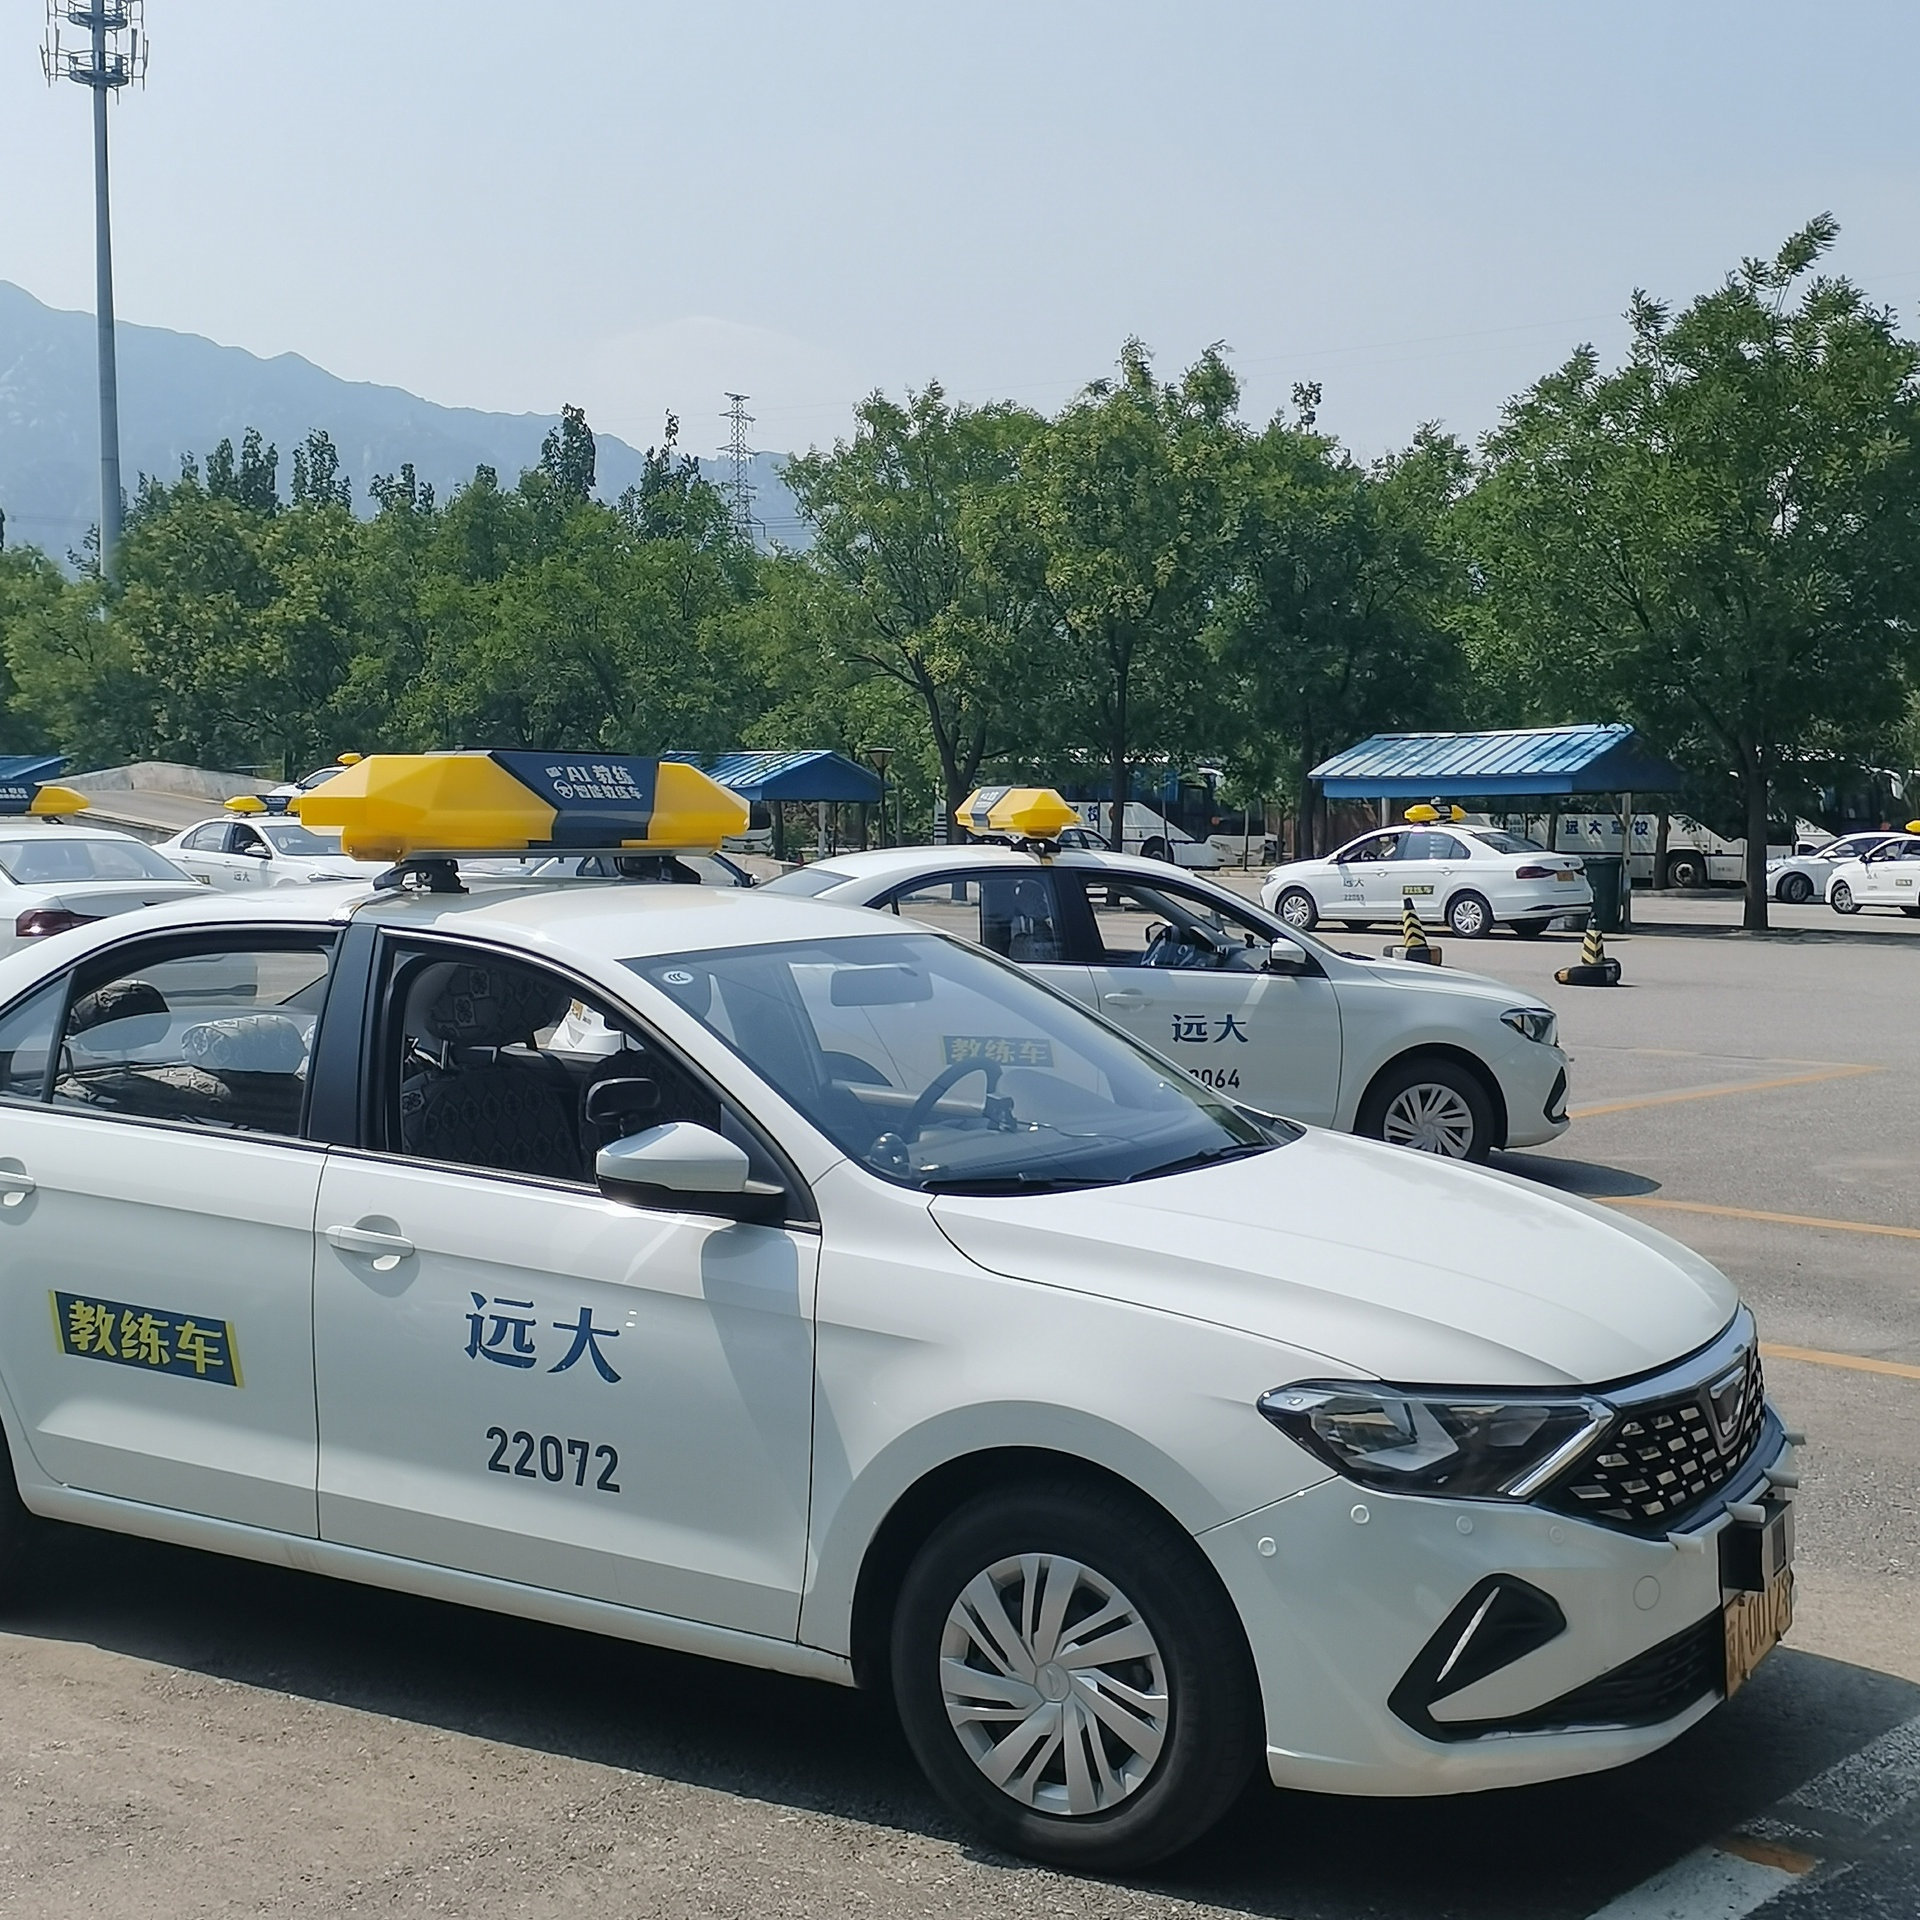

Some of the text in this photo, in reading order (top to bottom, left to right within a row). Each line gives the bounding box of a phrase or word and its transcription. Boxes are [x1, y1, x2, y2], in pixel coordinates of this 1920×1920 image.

[566, 764, 635, 784] AI 教练
[950, 1038, 1048, 1064] 教练车
[1172, 1014, 1249, 1043] 远大
[69, 1302, 224, 1373] 教练车
[465, 1292, 622, 1383] 远大
[486, 1427, 621, 1493] 22072
